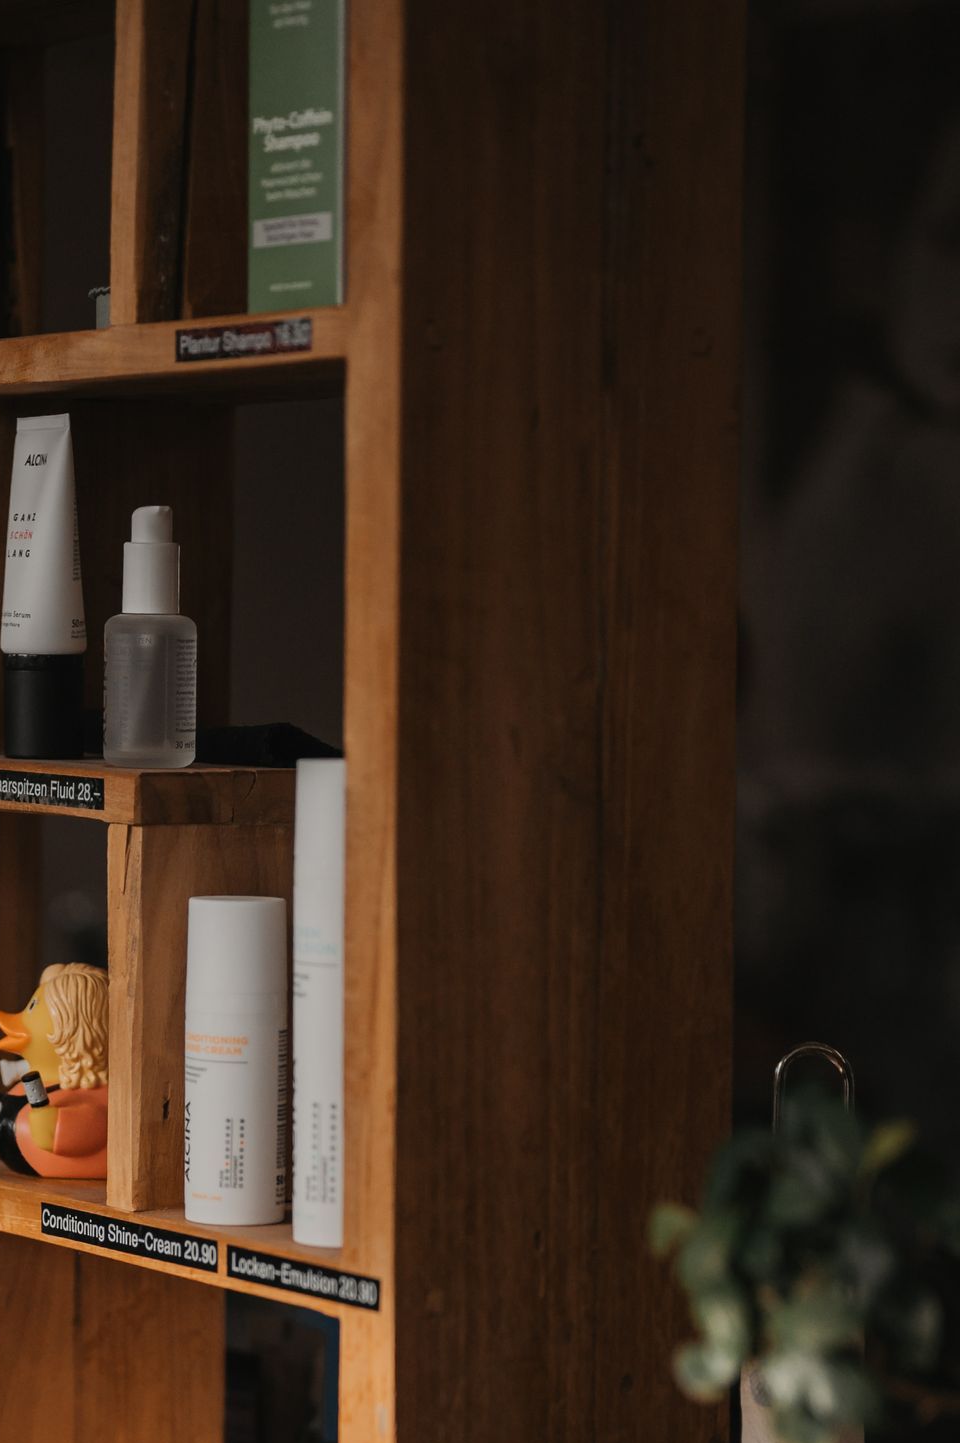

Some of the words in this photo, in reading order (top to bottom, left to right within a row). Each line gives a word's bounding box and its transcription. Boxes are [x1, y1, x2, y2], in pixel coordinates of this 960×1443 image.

[13, 512, 37, 522] GANZ
[7, 549, 30, 558] LANG
[50, 780, 75, 800] Fluid
[42, 1208, 105, 1242] Conditioning
[107, 1223, 182, 1257] Shine-Cream
[184, 1240, 217, 1266] 20.90
[231, 1251, 338, 1296] Locken-Emulsion
